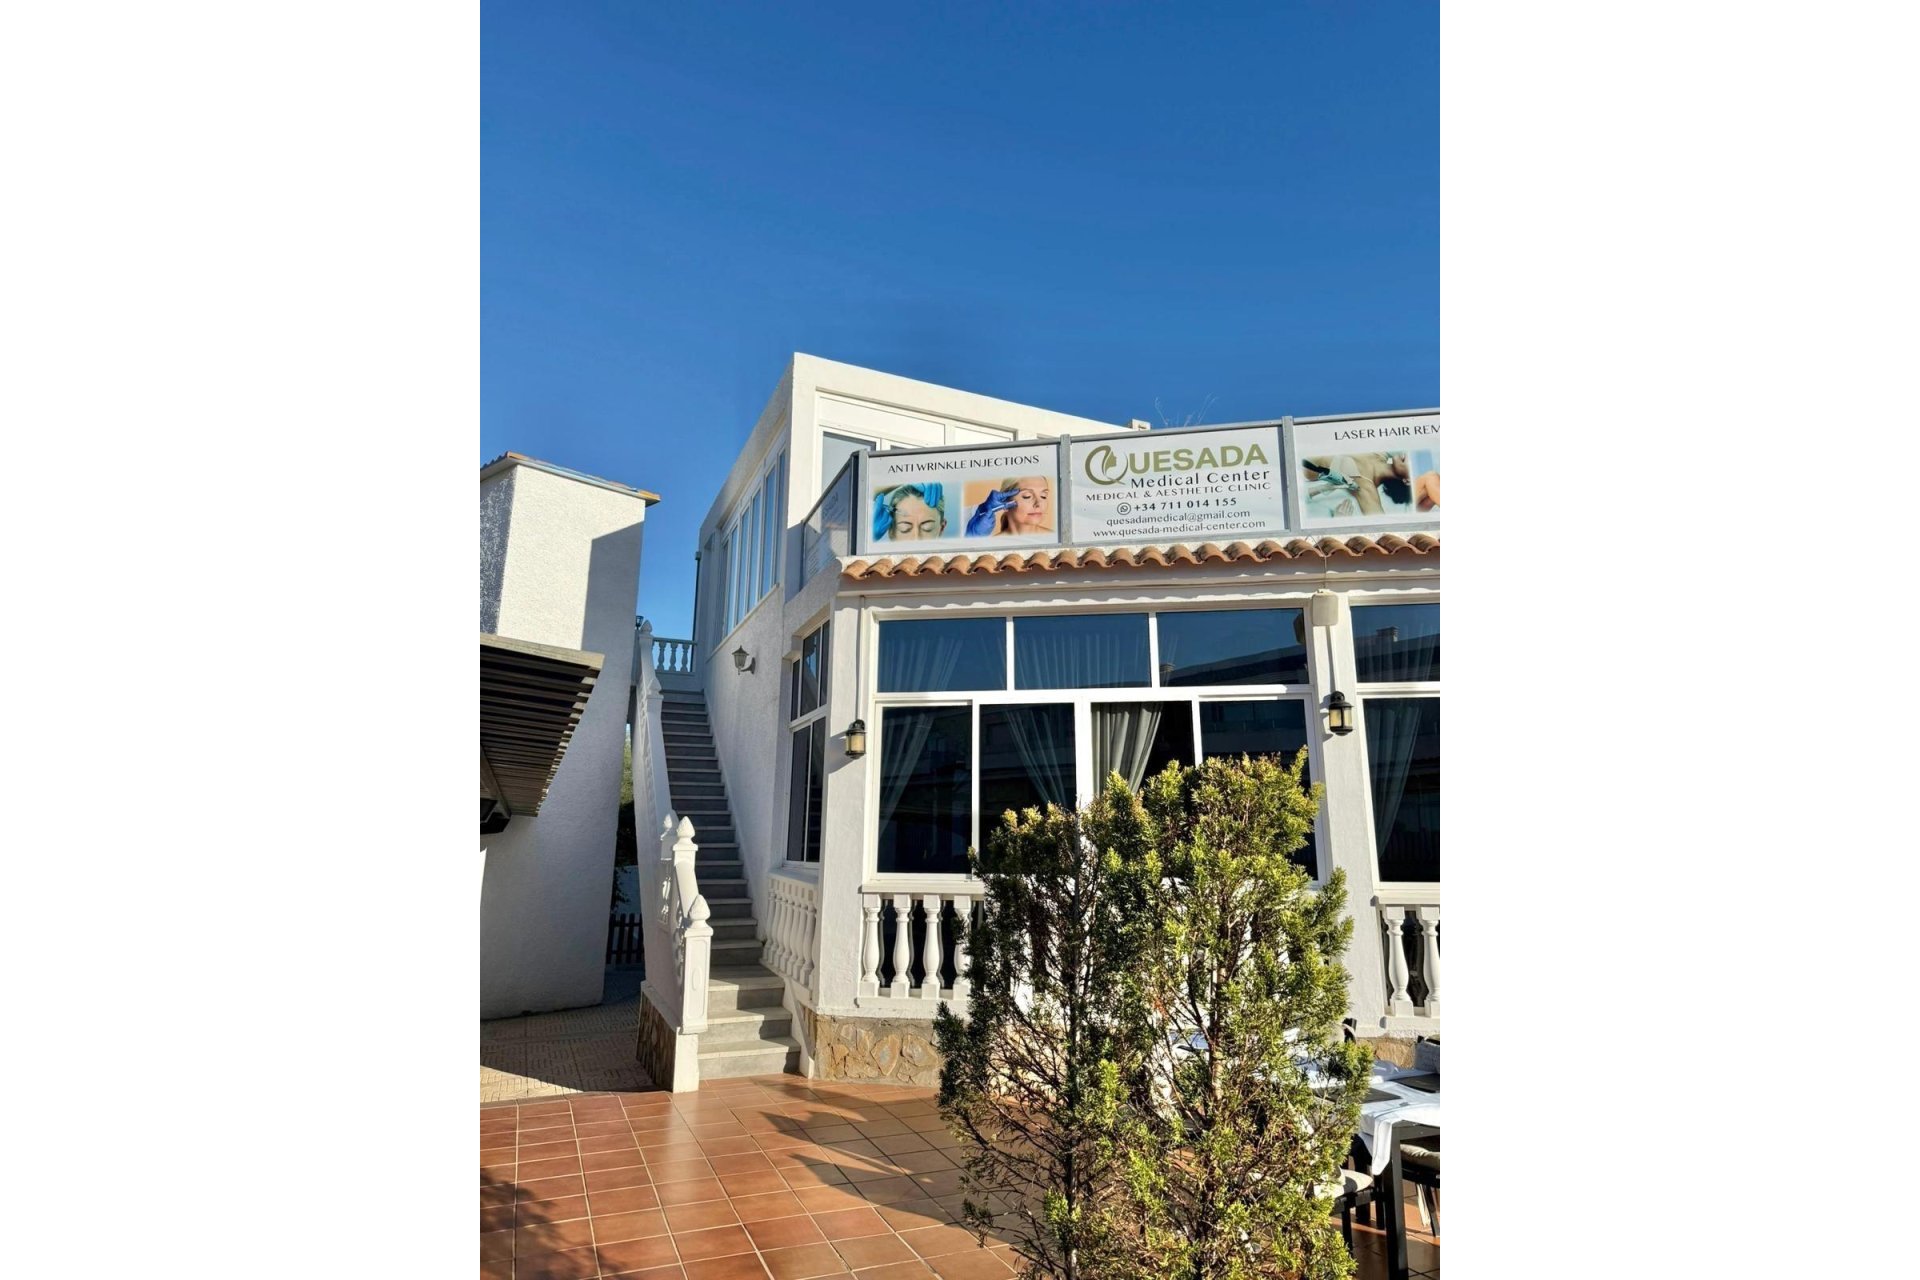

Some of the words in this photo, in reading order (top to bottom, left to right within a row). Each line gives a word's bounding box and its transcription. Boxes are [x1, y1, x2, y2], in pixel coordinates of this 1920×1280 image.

[1334, 429, 1376, 441] LASER
[1379, 426, 1410, 437] HAIR
[888, 463, 914, 474] ANTI
[916, 460, 967, 472] WRINKLE
[970, 455, 1040, 468] INJECTIONS
[1085, 443, 1268, 486] QUESADA
[1131, 473, 1199, 488] Medical
[1207, 470, 1270, 483] Center
[1086, 491, 1139, 501] MEDICAL
[1143, 490, 1152, 498] &
[1156, 486, 1223, 497] AESTHETIC
[1228, 482, 1271, 492] CLINIC
[1134, 503, 1156, 513] +34
[1161, 500, 1182, 511] 711
[1187, 499, 1210, 509] 014
[1215, 497, 1237, 507] 155
[1106, 510, 1251, 527] quesadamedical@gmail.com
[1093, 520, 1266, 537] www.quesada-medical-center.com
